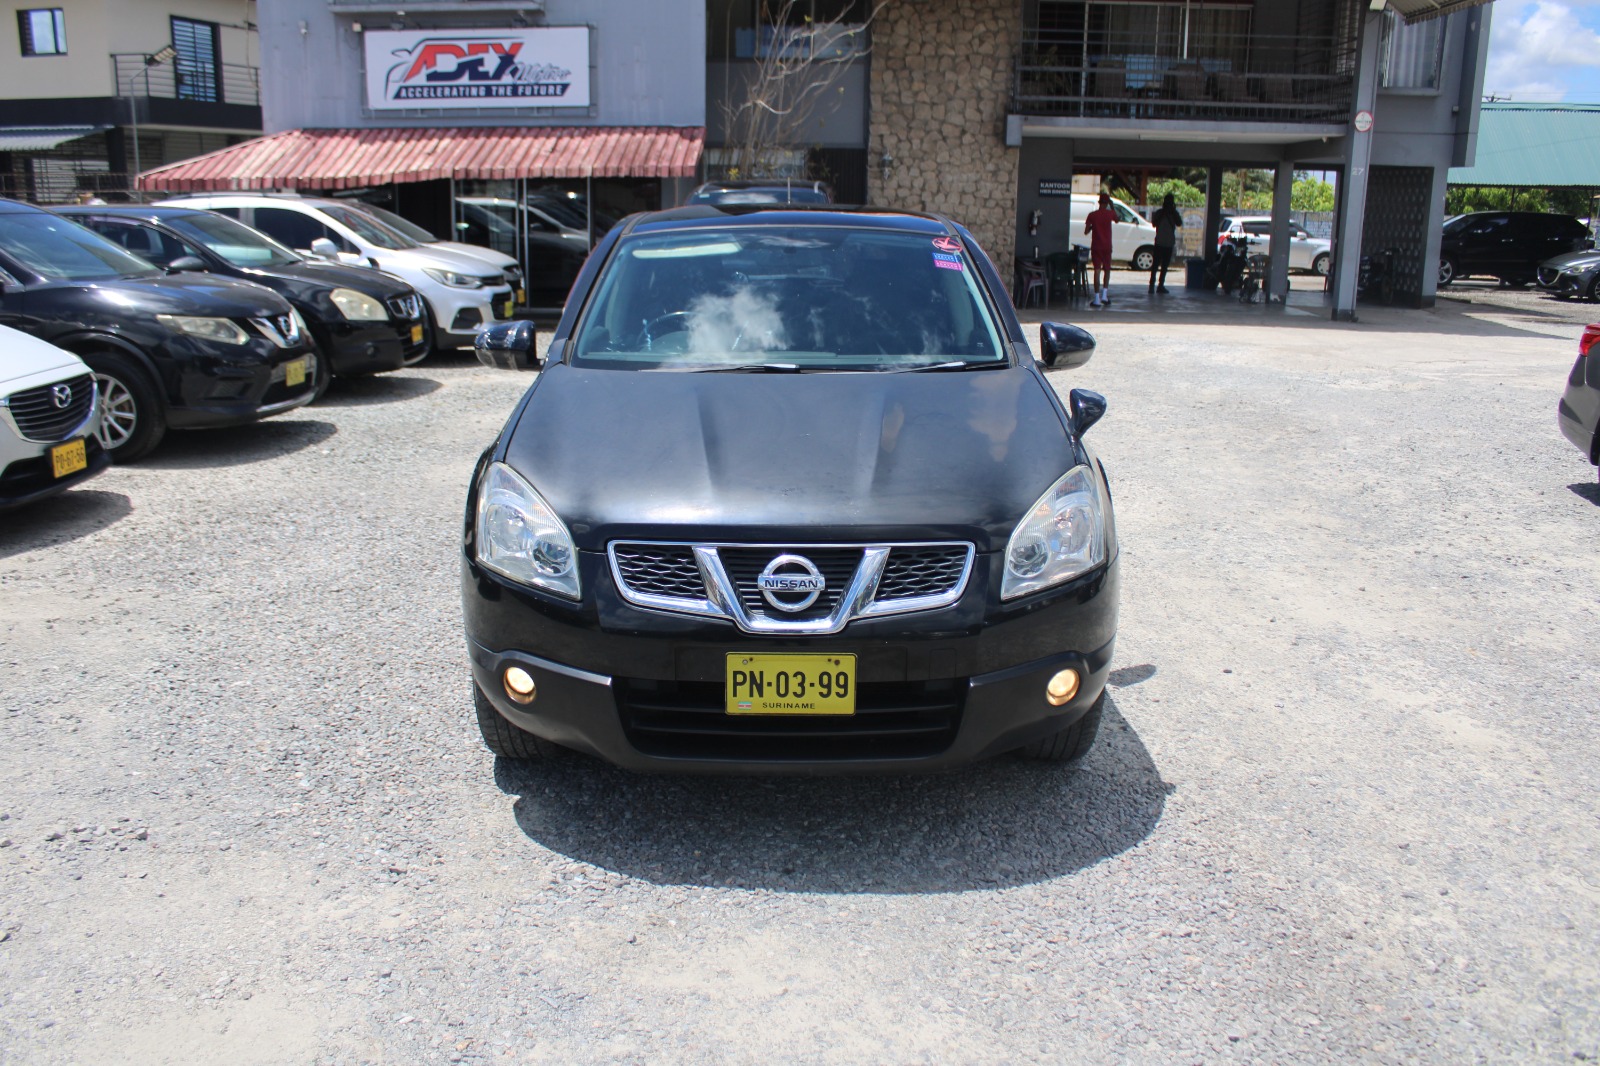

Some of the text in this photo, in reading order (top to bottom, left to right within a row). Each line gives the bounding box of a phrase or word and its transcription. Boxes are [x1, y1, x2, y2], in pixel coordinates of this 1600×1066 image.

[403, 42, 525, 82] ADEX
[400, 84, 564, 99] ACCELERATING THE FUTURE
[1351, 167, 1365, 176] 27
[764, 579, 818, 589] NISSAN
[762, 702, 816, 710] SURINAME
